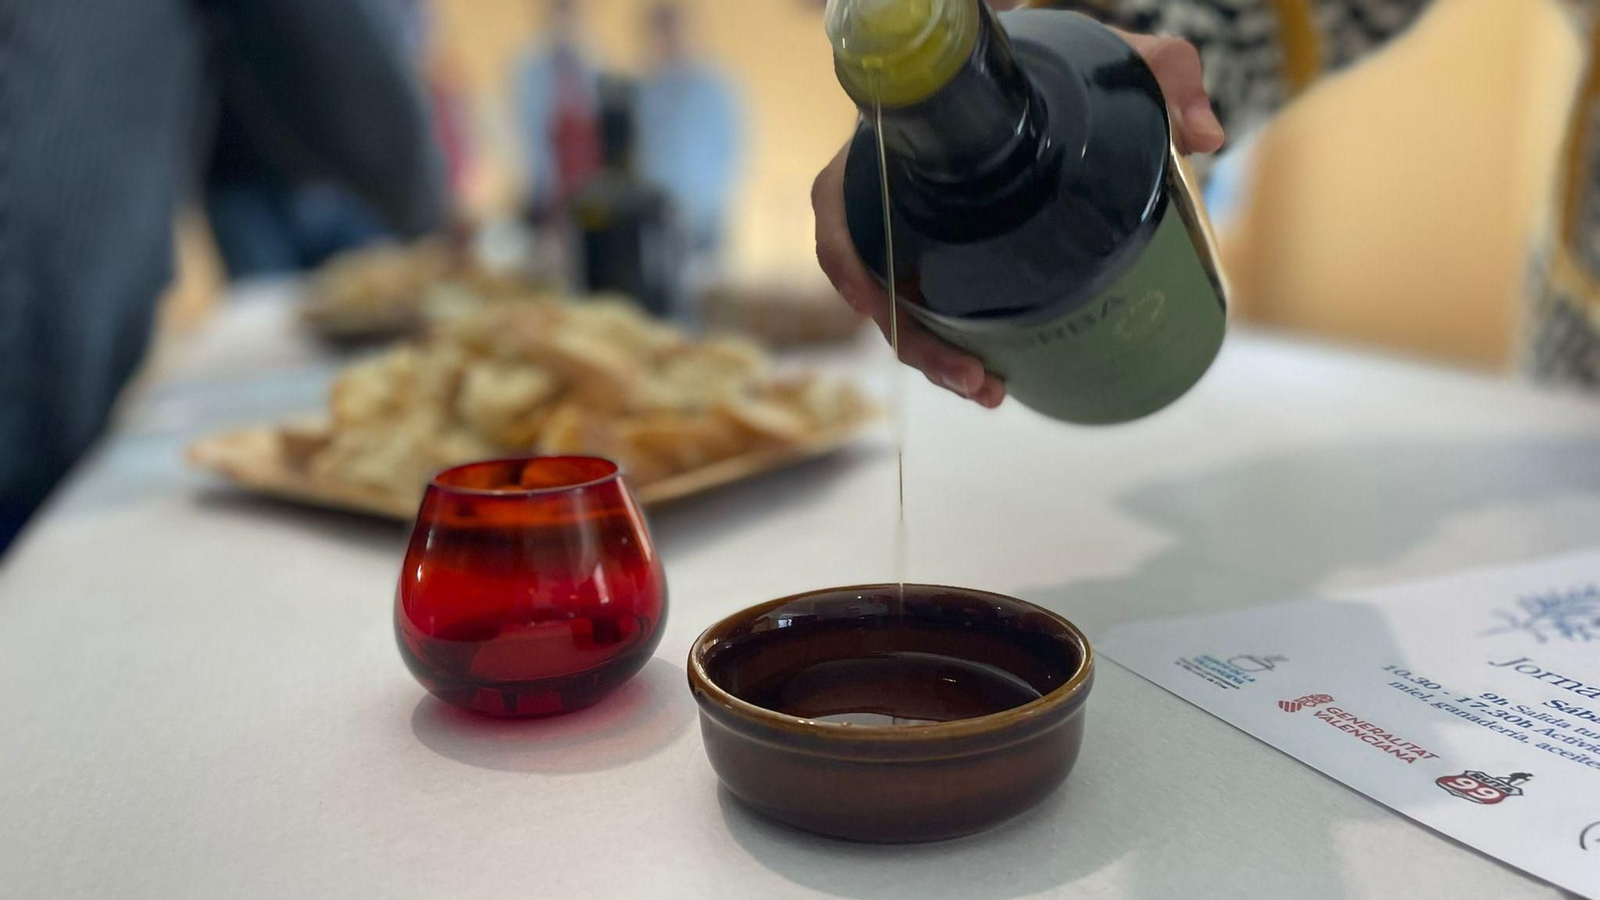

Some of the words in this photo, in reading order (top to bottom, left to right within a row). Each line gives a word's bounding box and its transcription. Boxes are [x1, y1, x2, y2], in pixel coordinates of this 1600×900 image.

[1382, 665, 1441, 690] 10.30
[1455, 697, 1533, 728] 17.30h
[1388, 681, 1434, 702] miel,
[1430, 702, 1529, 744] ganadería,
[1479, 692, 1508, 706] 9h
[1510, 705, 1571, 728] Salida
[1313, 710, 1417, 764] VALENCIANA
[1326, 706, 1440, 760] GENERALITAT
[1446, 777, 1501, 799] 99
[1470, 773, 1514, 794] RUTA
